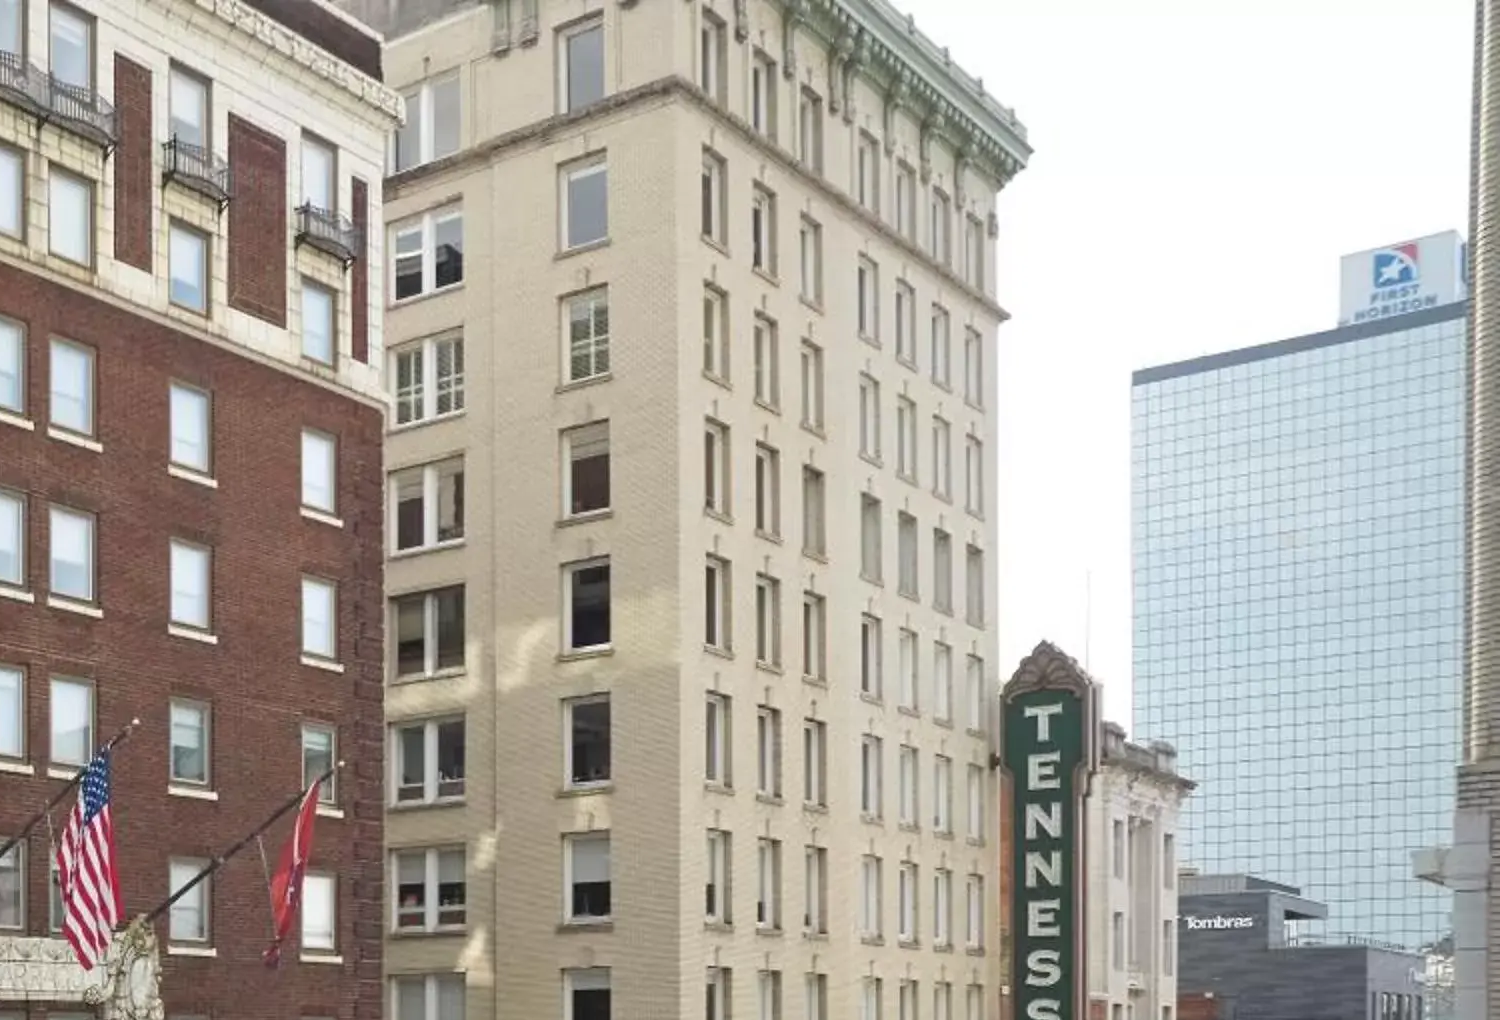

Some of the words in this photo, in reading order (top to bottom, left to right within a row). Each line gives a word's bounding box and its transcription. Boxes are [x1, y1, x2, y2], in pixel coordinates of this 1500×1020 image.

[1370, 283, 1420, 304] FIRST
[1354, 293, 1438, 321] HORIZON
[1185, 915, 1254, 929] Tombras
